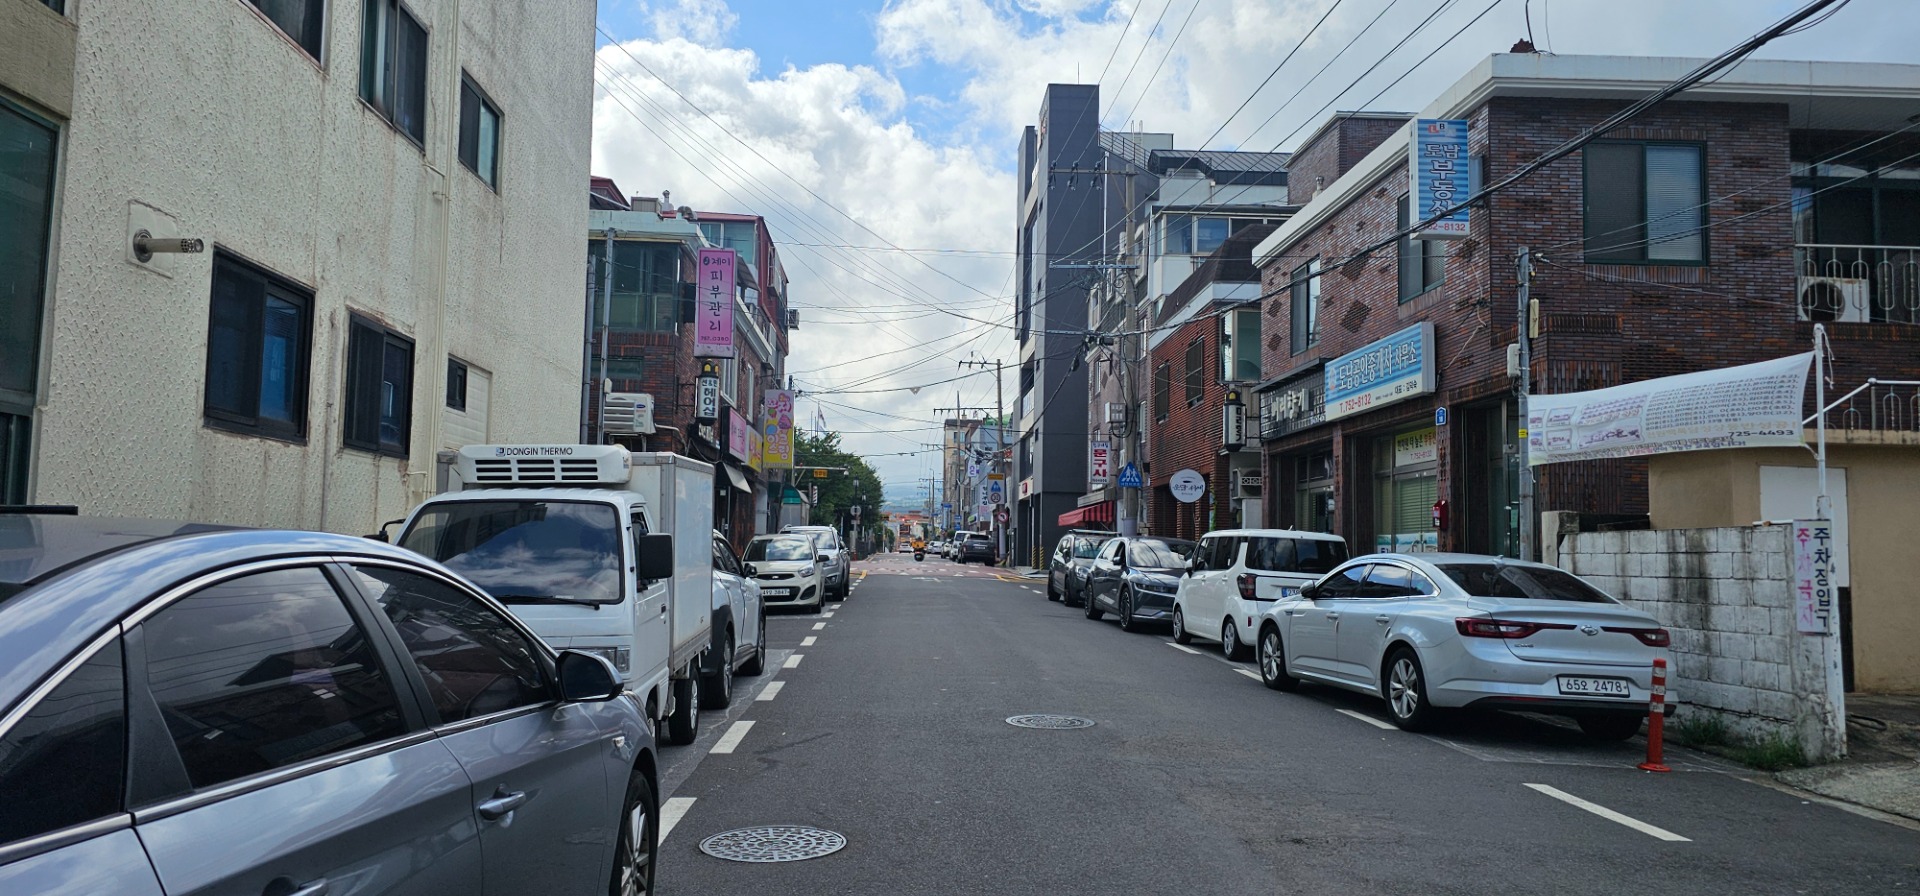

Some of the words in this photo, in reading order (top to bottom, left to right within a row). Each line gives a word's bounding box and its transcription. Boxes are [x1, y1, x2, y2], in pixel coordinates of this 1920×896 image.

[1424, 144, 1461, 158] 도남
[1429, 160, 1457, 219] 부동산
[708, 269, 723, 332] 피부관리
[1394, 341, 1417, 370] 사무소
[1339, 393, 1372, 414] T.752-8132
[1727, 429, 1795, 438] 725-4493
[506, 447, 539, 456] DONGIN
[540, 447, 573, 456] THERMO
[1093, 449, 1108, 478] 문구사
[1813, 527, 1831, 628] 주차장입구
[1566, 678, 1588, 690] 65오
[1594, 680, 1623, 693] 2478
